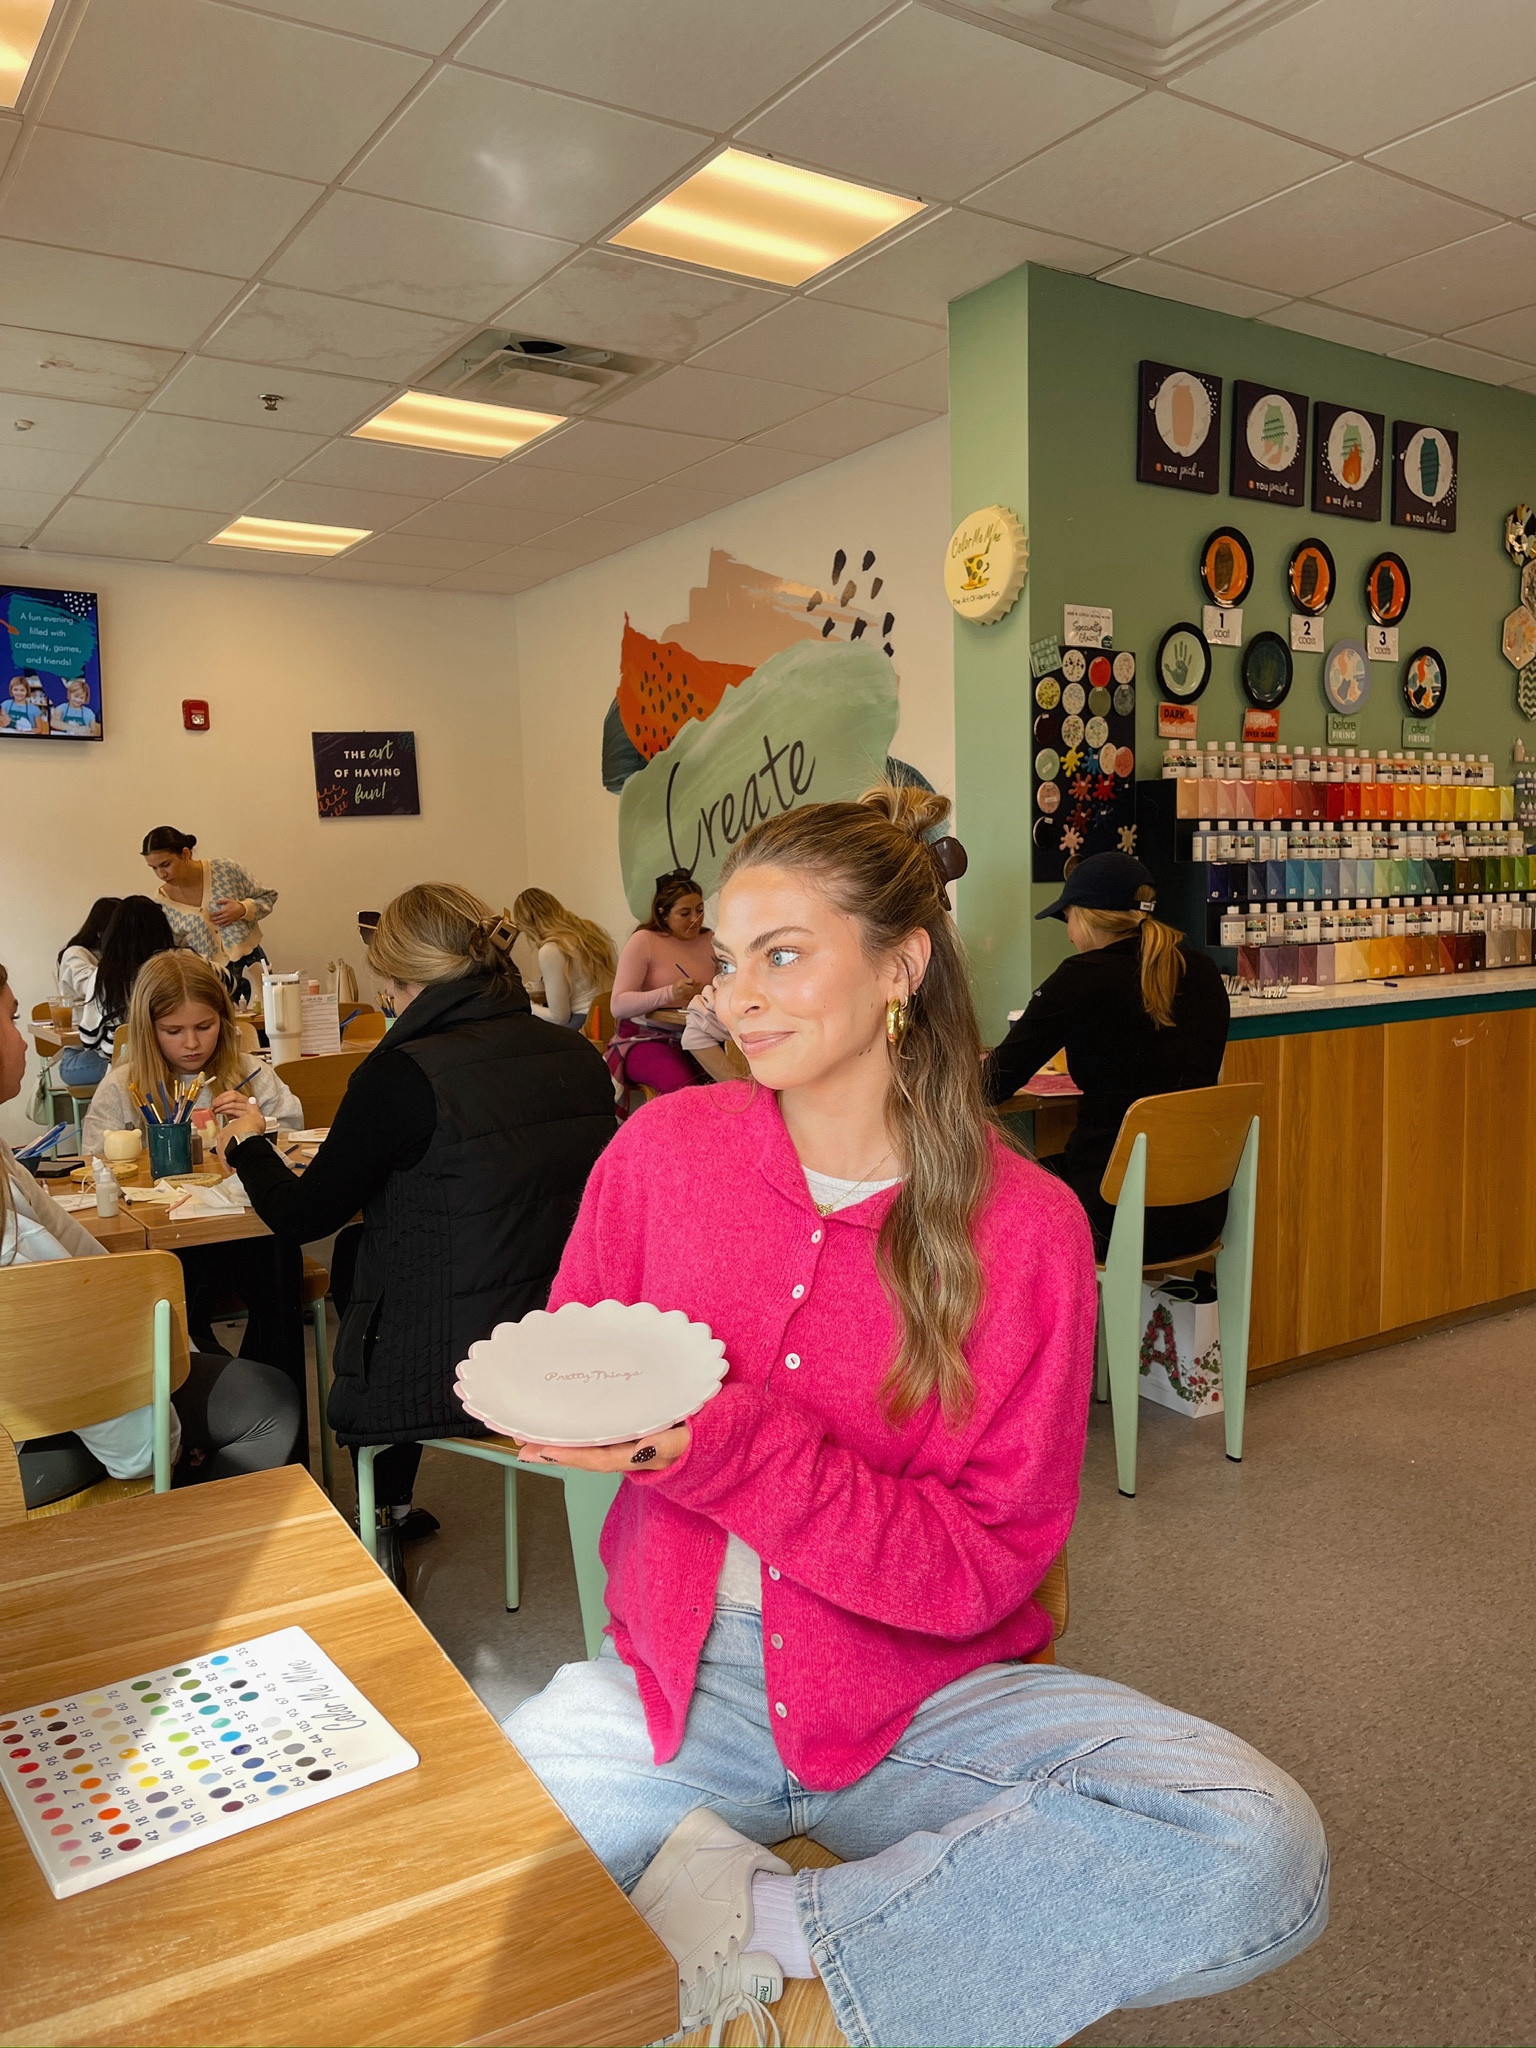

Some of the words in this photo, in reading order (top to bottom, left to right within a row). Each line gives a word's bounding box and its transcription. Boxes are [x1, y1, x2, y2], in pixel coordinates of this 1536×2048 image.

[1163, 464, 1178, 474] YOU
[1179, 462, 1197, 480] pick
[1256, 482, 1269, 492] YOU
[1268, 482, 1289, 497] paint
[1412, 514, 1424, 523] YOU
[951, 531, 972, 559] Color
[20, 612, 27, 620] A
[28, 612, 41, 621] fun
[43, 616, 74, 626] evening
[1219, 612, 1225, 628] 1
[29, 627, 48, 636] filled
[1303, 621, 1311, 635] 2
[1213, 628, 1230, 639] coat
[1379, 631, 1386, 645] 3
[1297, 636, 1317, 646] coats
[14, 642, 52, 652] creativity,
[53, 645, 82, 653] games,
[1373, 646, 1392, 656] coats
[26, 656, 41, 664] and
[43, 656, 72, 666] friends!
[1163, 708, 1186, 719] DARK
[1332, 716, 1357, 730] before
[1411, 721, 1427, 734] after
[1332, 731, 1356, 740] FIRING
[1407, 734, 1430, 743] FIRING
[343, 750, 366, 759] THE
[368, 740, 394, 760] art
[334, 769, 349, 778] OF
[354, 768, 401, 778] HAVING
[354, 781, 387, 804] fun!
[666, 735, 816, 873] Create
[544, 1371, 590, 1384] Pretty
[236, 1647, 249, 1656] 35
[196, 1661, 209, 1669] 49
[245, 1659, 258, 1667] 62
[281, 1659, 324, 1683] Mine
[205, 1672, 218, 1681] 82
[163, 1687, 177, 1696] 29
[214, 1686, 228, 1694] 39
[264, 1683, 277, 1692] 45
[297, 1684, 340, 1701] Me
[107, 1690, 120, 1699] 76
[171, 1699, 185, 1708] 48
[224, 1698, 237, 1707] 59
[275, 1697, 289, 1705] 67
[64, 1702, 78, 1712] 25
[115, 1702, 129, 1711] 68
[181, 1712, 195, 1722] 14
[234, 1710, 248, 1720] 55
[286, 1708, 299, 1718] 93
[310, 1702, 367, 1731] Color
[22, 1715, 35, 1725] 13
[72, 1715, 86, 1725] 15
[123, 1715, 137, 1725] 88
[191, 1725, 205, 1735] 22
[245, 1723, 259, 1733] 85
[296, 1720, 312, 1732] 105
[29, 1728, 44, 1738] 30
[80, 1728, 94, 1739] 61
[132, 1727, 147, 1739] 72
[201, 1739, 217, 1749] 27
[256, 1736, 269, 1745] 43
[308, 1734, 323, 1744] 44
[37, 1741, 51, 1752] 90
[89, 1742, 103, 1752] 12
[142, 1742, 156, 1752] 21
[267, 1749, 281, 1760] 11
[322, 1747, 336, 1758] 70
[45, 1755, 59, 1766] 98
[98, 1757, 112, 1767] 73
[151, 1757, 165, 1766] 19
[211, 1754, 226, 1762] 17
[277, 1764, 292, 1773] 47
[333, 1761, 347, 1770] 31
[54, 1770, 69, 1781] 66
[160, 1770, 174, 1780] 46
[222, 1766, 237, 1776] 91
[106, 1772, 122, 1782] 57
[289, 1776, 305, 1787] 64
[232, 1780, 247, 1789] 41
[115, 1786, 131, 1796] 69
[171, 1785, 185, 1796] 10
[244, 1793, 259, 1804] 83
[124, 1798, 142, 1814] 104
[181, 1798, 197, 1810] 92
[134, 1815, 150, 1826] 18
[190, 1811, 208, 1826] 101
[89, 1831, 104, 1843] 86
[144, 1829, 160, 1841] 42
[99, 1847, 113, 1860] 16
